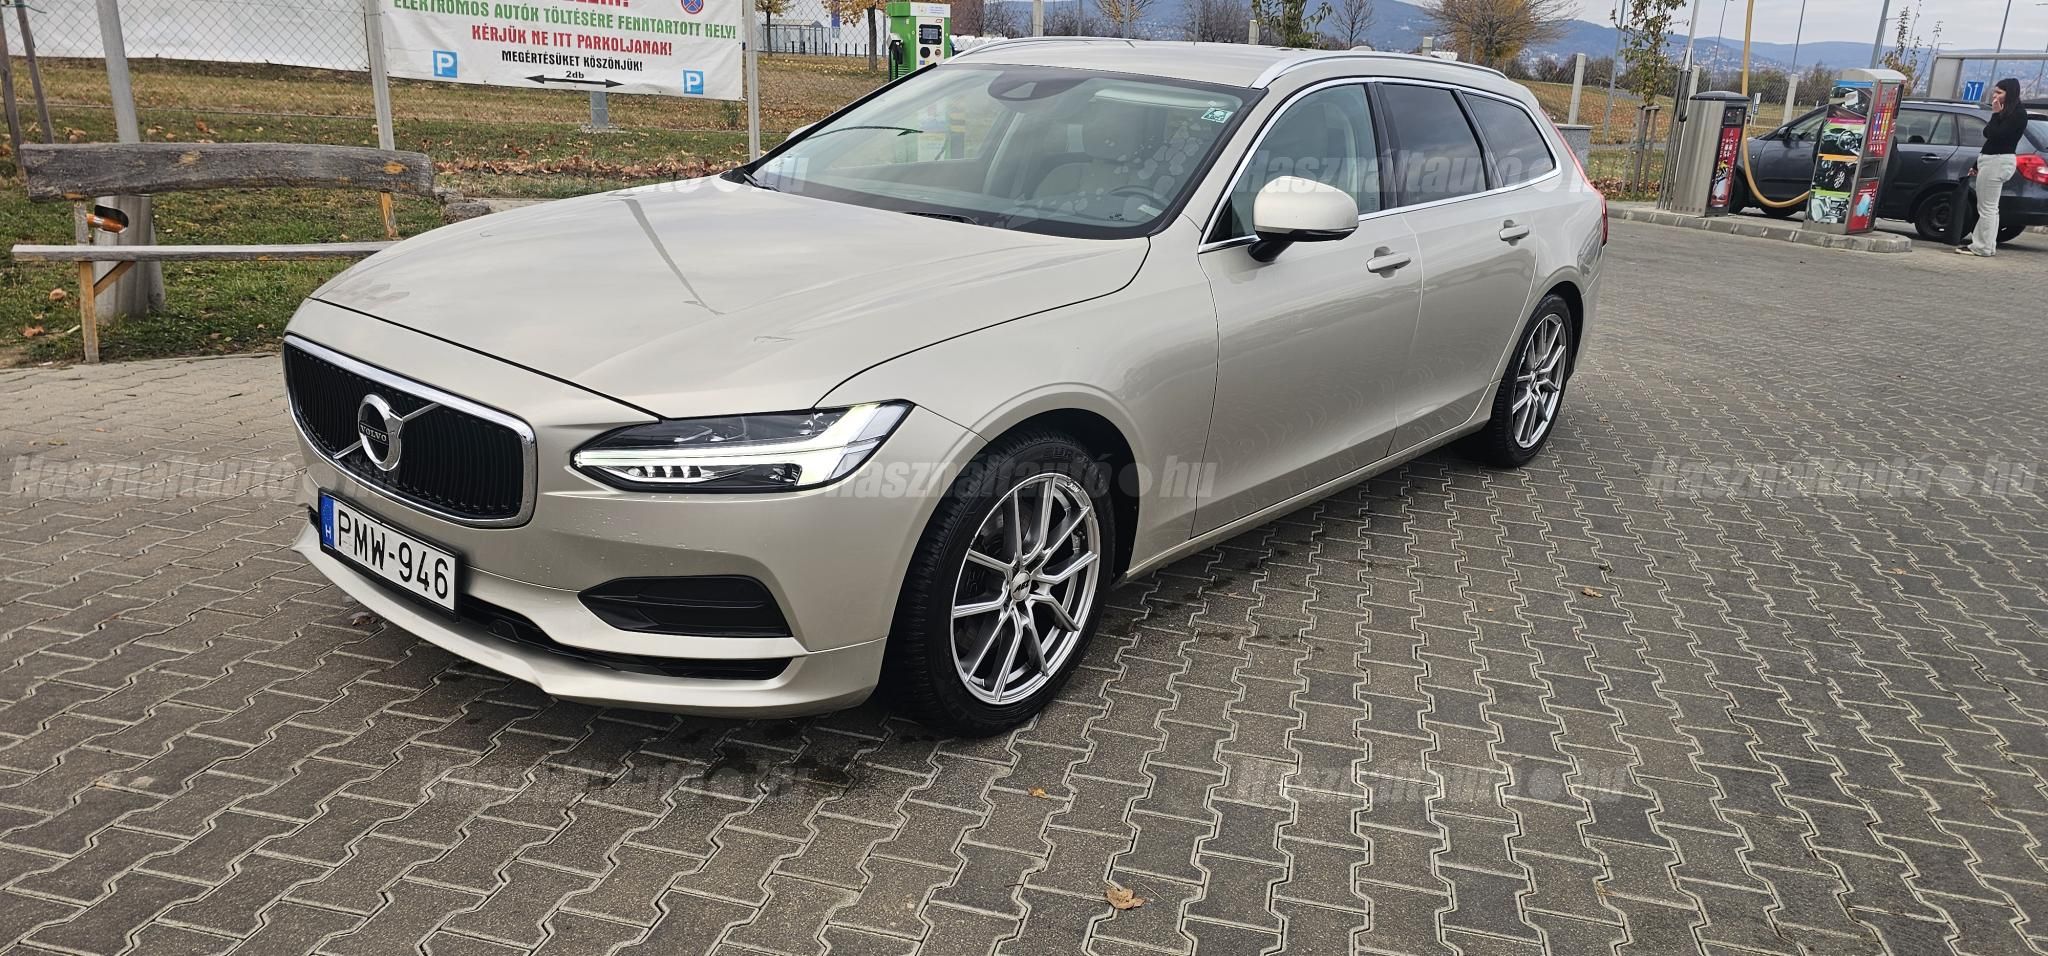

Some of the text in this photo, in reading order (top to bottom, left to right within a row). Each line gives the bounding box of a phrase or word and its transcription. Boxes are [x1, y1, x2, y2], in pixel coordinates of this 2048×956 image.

[394, 0, 489, 17] ELEKTROMOS
[494, 4, 539, 22] AUTÓK
[543, 6, 614, 29] TÖLTÉSÉRE
[618, 15, 701, 36] FENNTARTOTT
[705, 23, 737, 39] HELY!
[472, 23, 673, 56] KÉRJÜK NE ITT PARKOLJANAK!
[435, 53, 454, 75] P
[501, 49, 643, 72] MEGÉRTÉSÜKET KÖSZÖNJÜK!
[565, 70, 585, 79] 2db
[686, 72, 700, 92] P
[360, 425, 387, 442] VOLVO
[324, 509, 449, 600] H PMW-946
